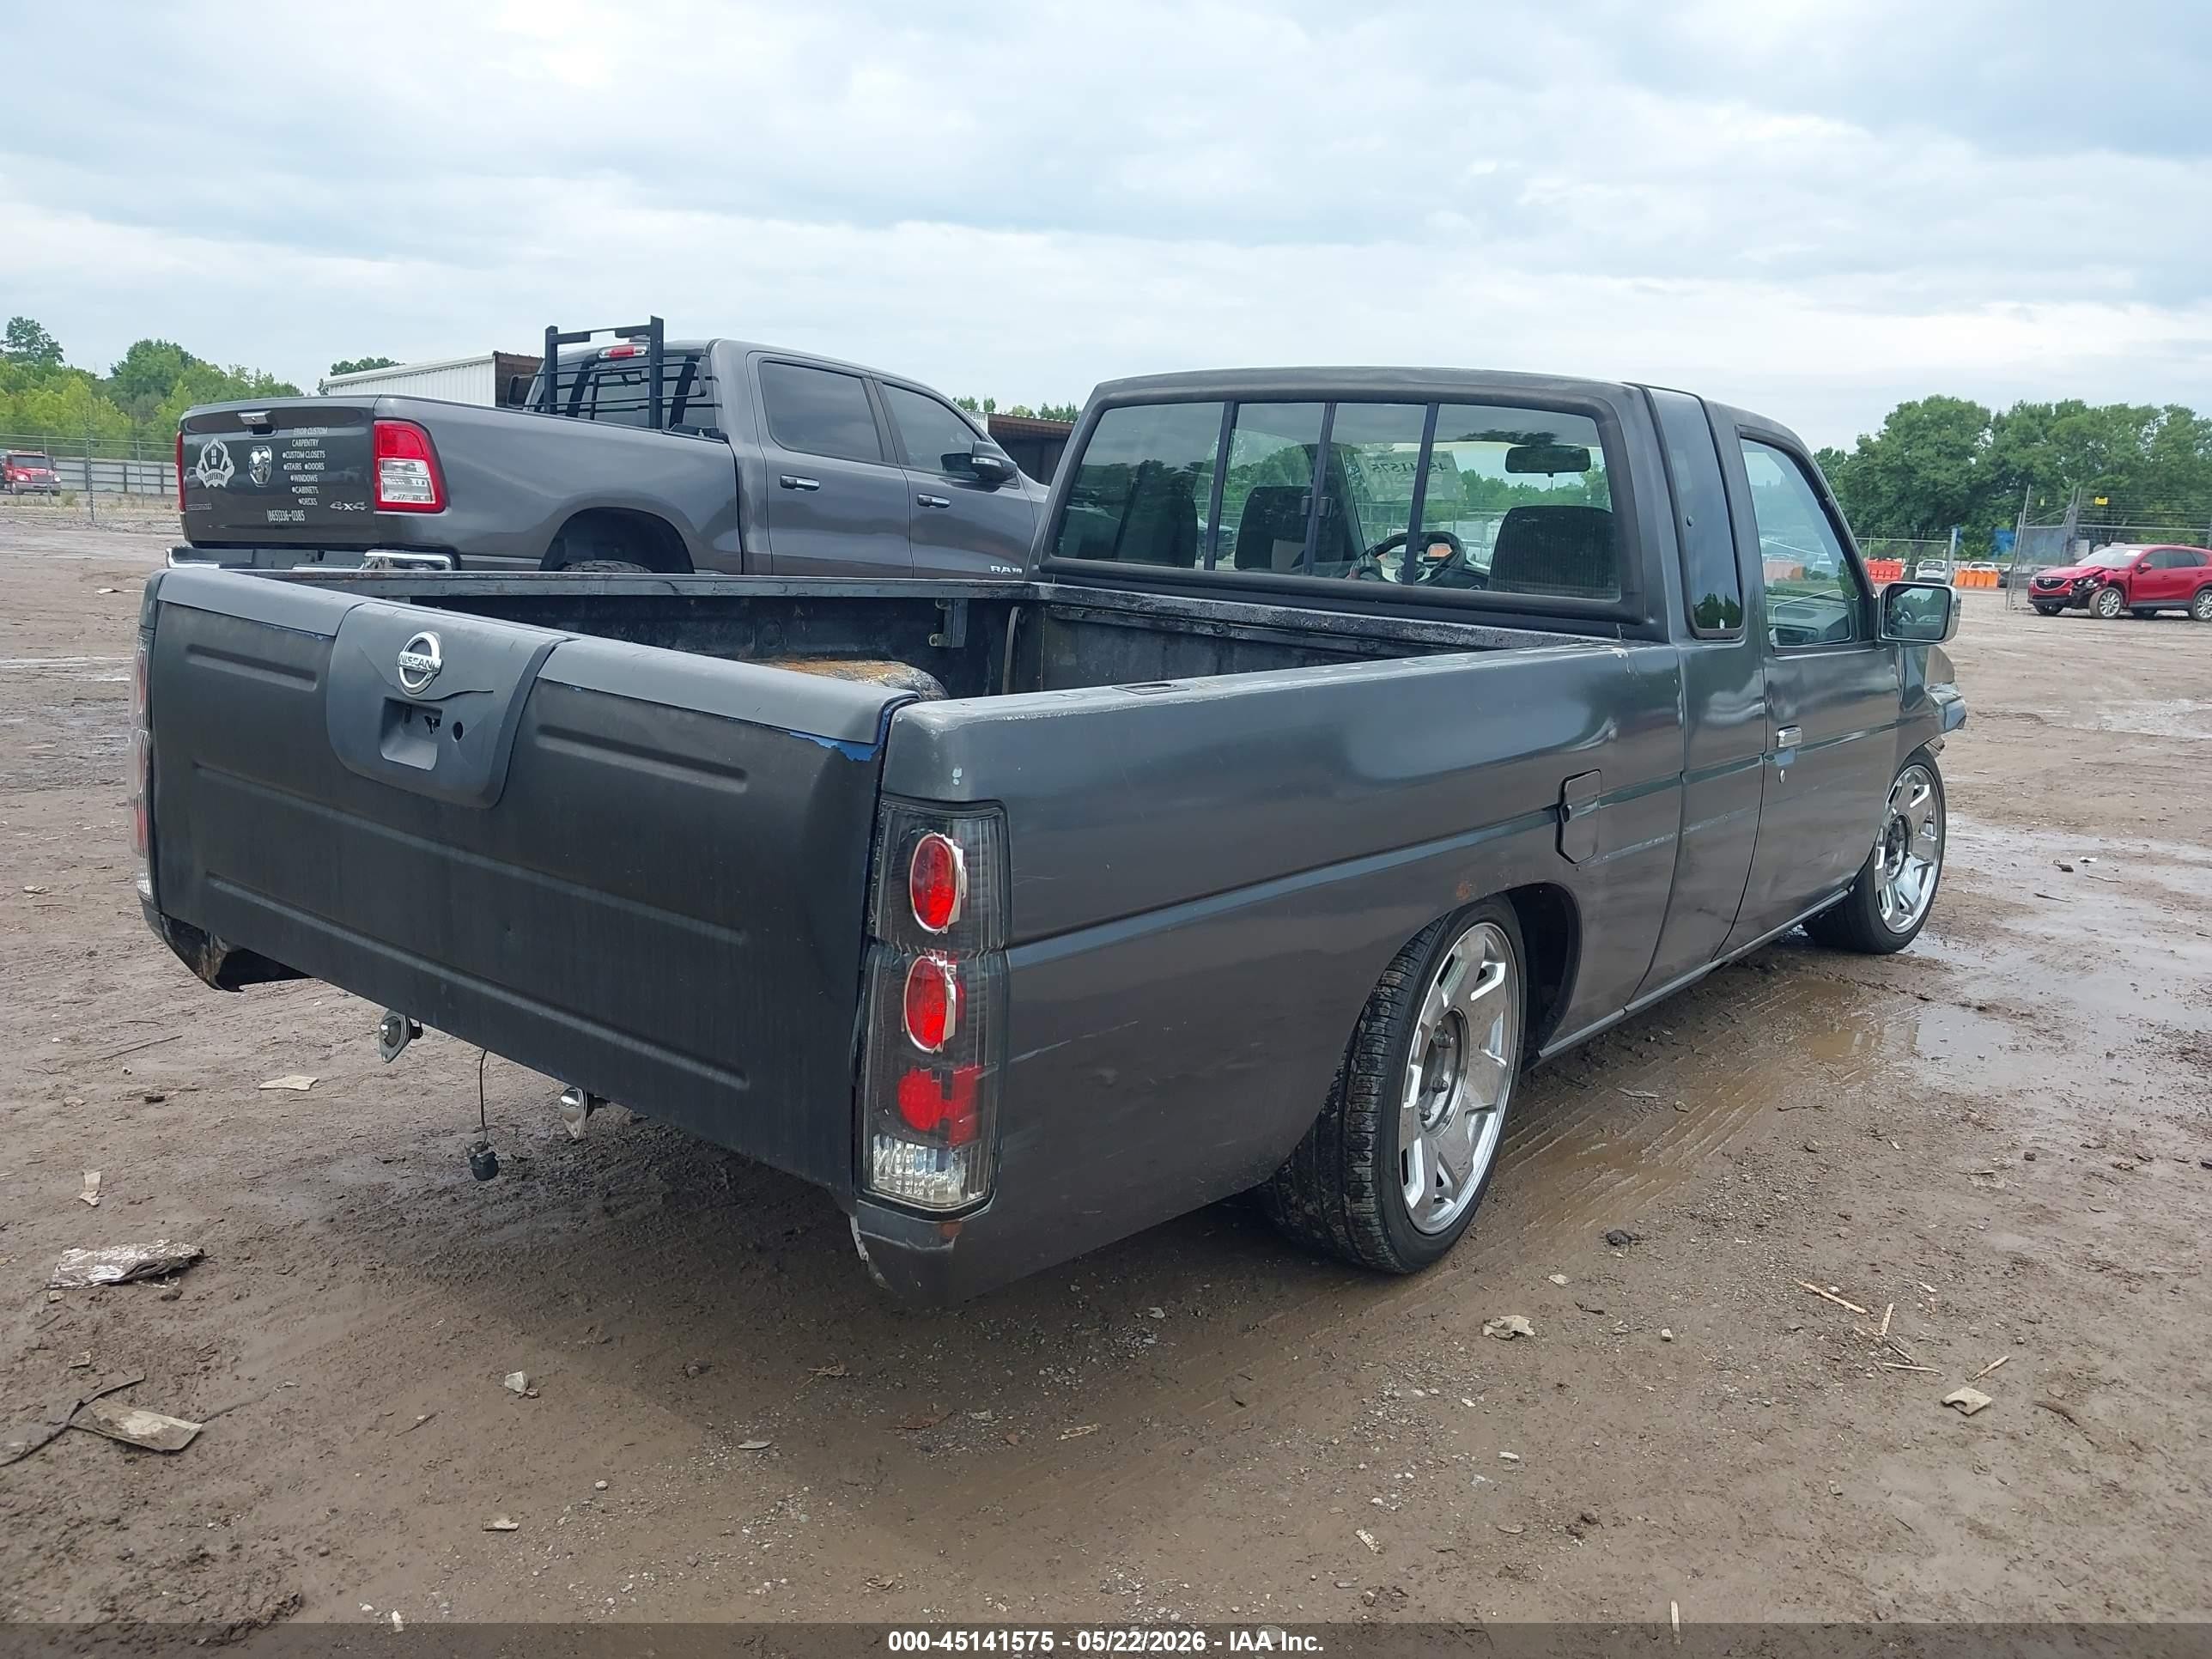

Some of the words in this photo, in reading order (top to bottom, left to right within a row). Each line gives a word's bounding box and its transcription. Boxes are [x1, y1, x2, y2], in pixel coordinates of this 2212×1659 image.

[291, 439, 319, 447] CARPENTRY
[305, 450, 326, 459] CLOSETS
[307, 462, 325, 471] DOORS
[204, 471, 225, 483] CARPENTRY
[295, 486, 319, 495] CABINETS
[990, 565, 1022, 574] RAM
[400, 654, 434, 670] NISSAN
